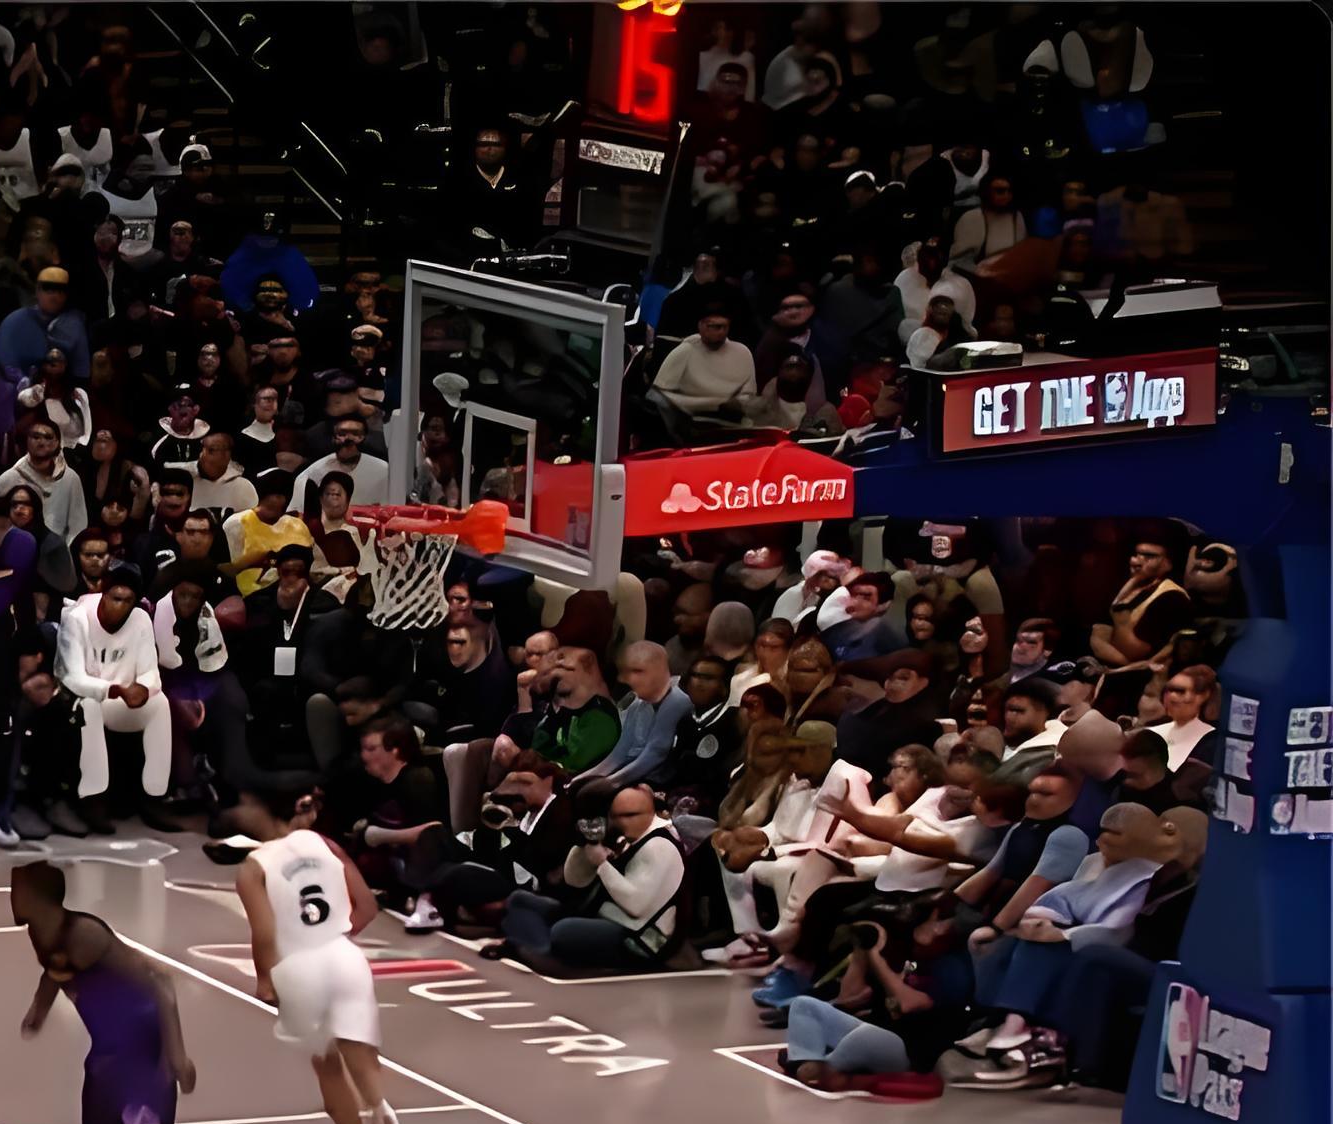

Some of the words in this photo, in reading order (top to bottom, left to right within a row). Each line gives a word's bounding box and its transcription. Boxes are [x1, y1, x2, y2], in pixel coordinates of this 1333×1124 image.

[974, 382, 1031, 435] GET
[1040, 375, 1096, 430] THE
[299, 885, 330, 925] 5
[408, 978, 671, 1077] ULTRA
